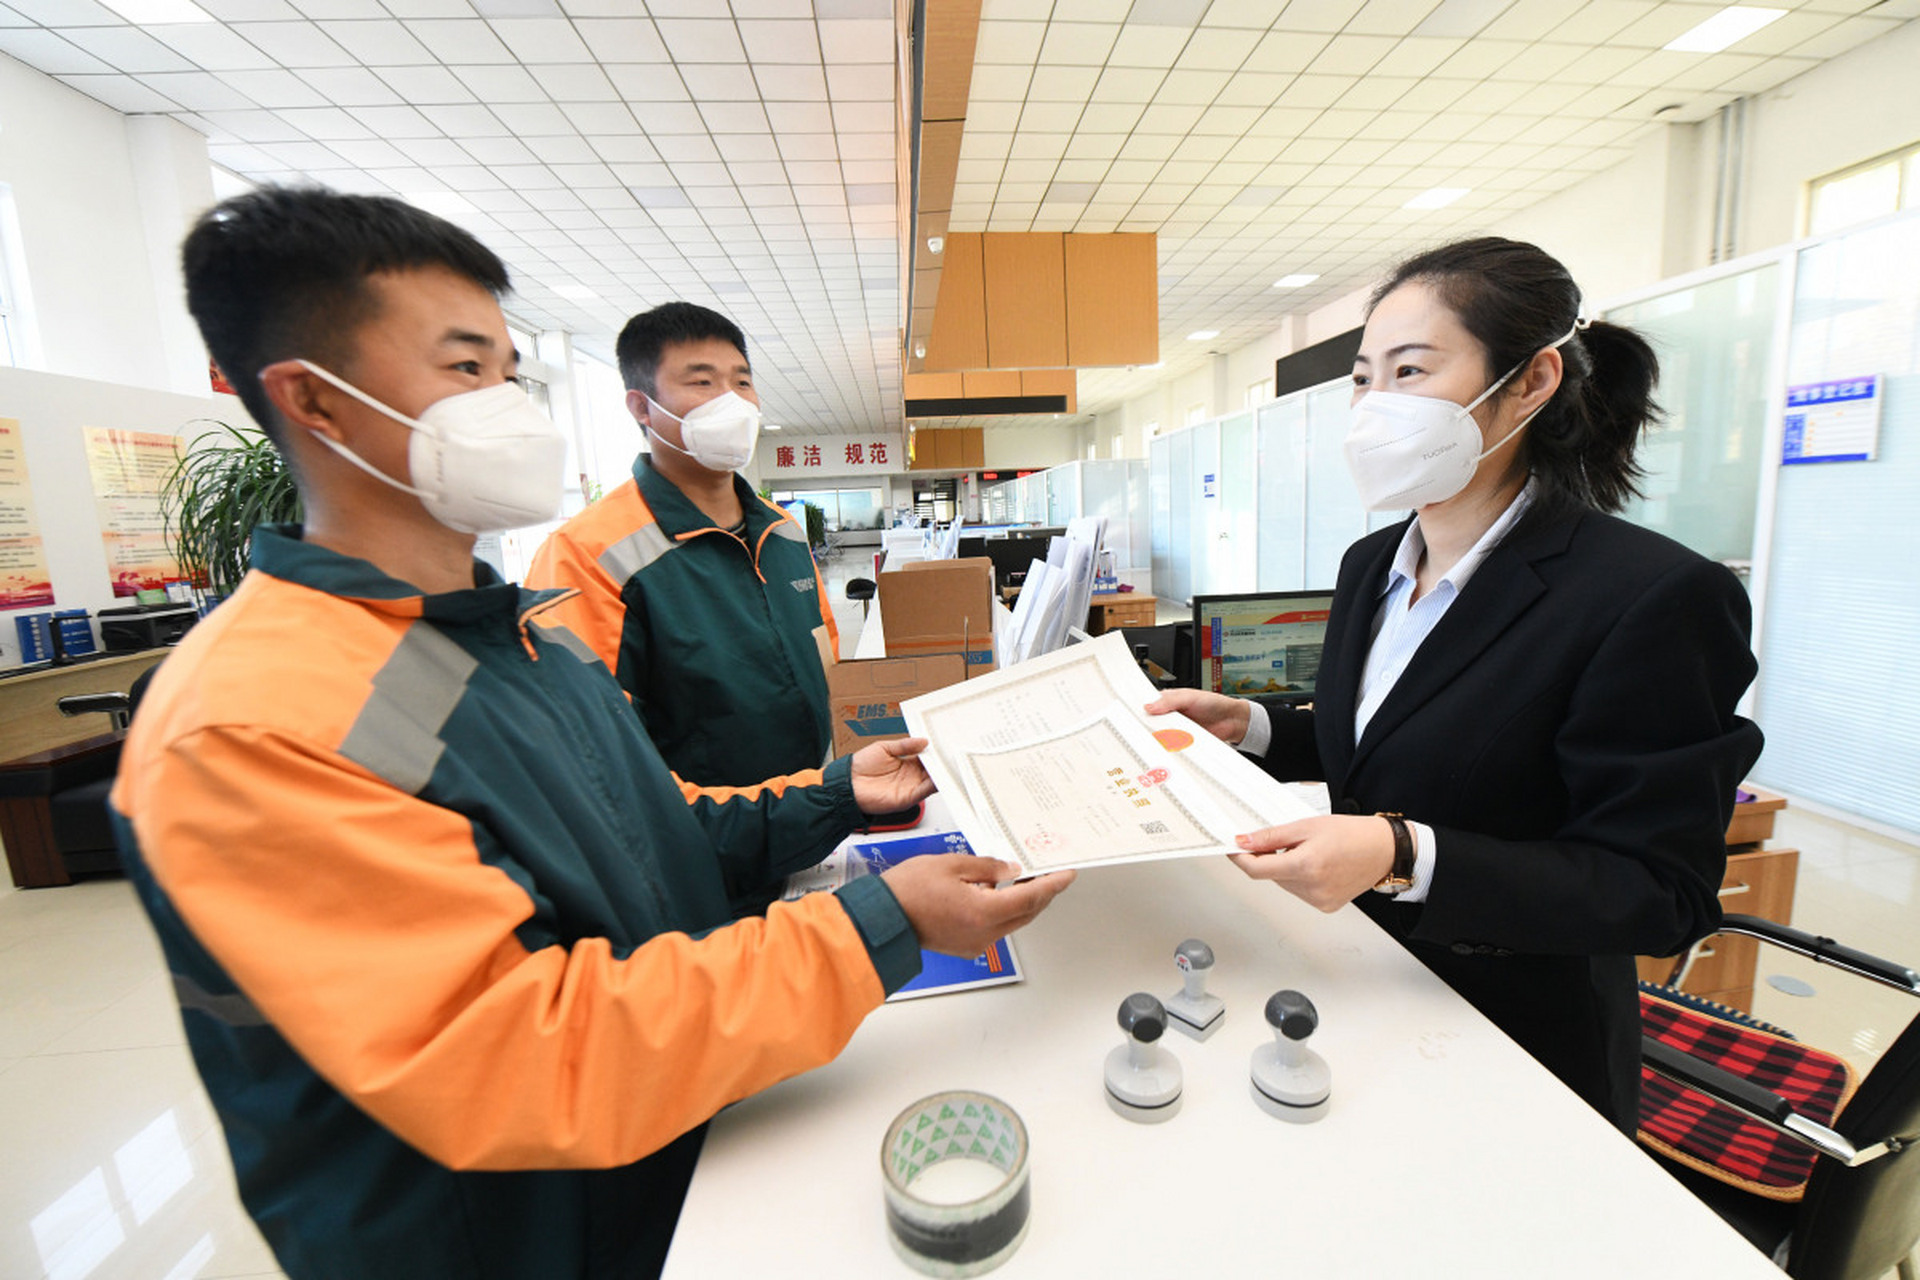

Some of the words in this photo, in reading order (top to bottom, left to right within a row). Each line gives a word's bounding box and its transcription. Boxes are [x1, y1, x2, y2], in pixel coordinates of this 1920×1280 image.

[776, 444, 822, 468] 廉洁
[845, 442, 888, 465] 规范
[857, 703, 887, 719] EMS
